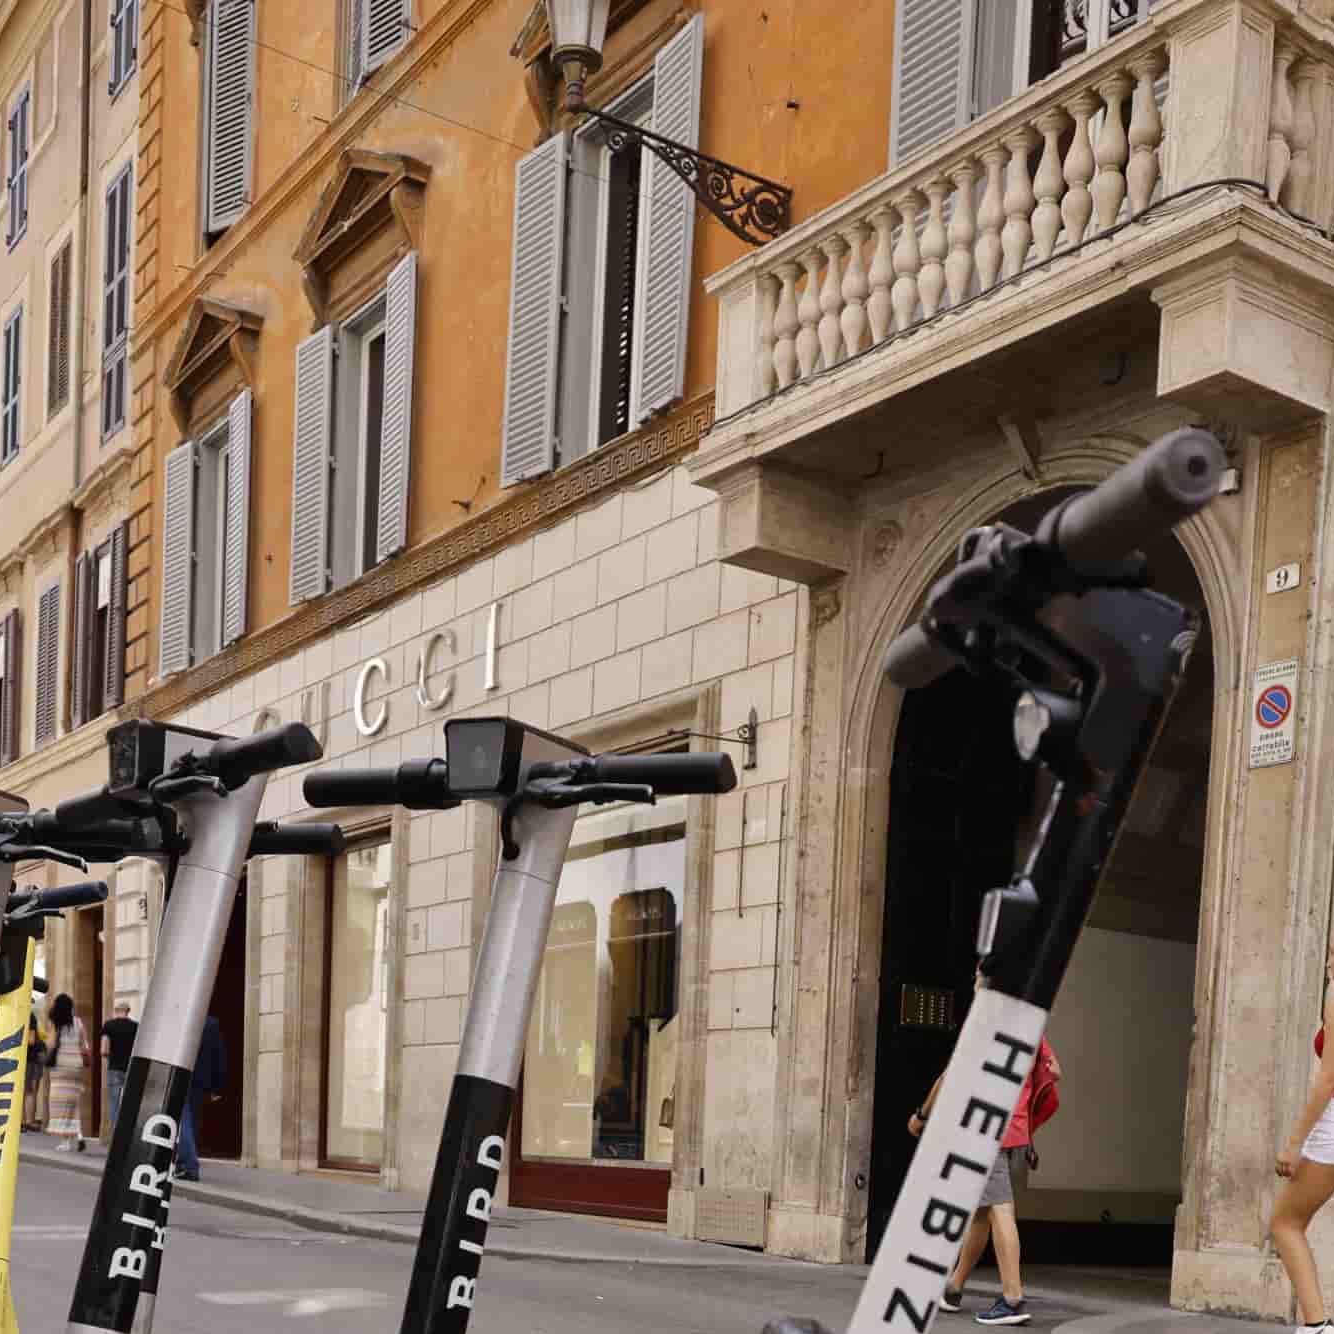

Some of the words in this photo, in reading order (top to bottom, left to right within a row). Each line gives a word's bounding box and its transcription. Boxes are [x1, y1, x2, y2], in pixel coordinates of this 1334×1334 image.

[1275, 567, 1289, 589] 9
[107, 1113, 178, 1280] BIRD
[446, 1135, 506, 1310] BIRD
[882, 1031, 1036, 1334] HELBIZ
